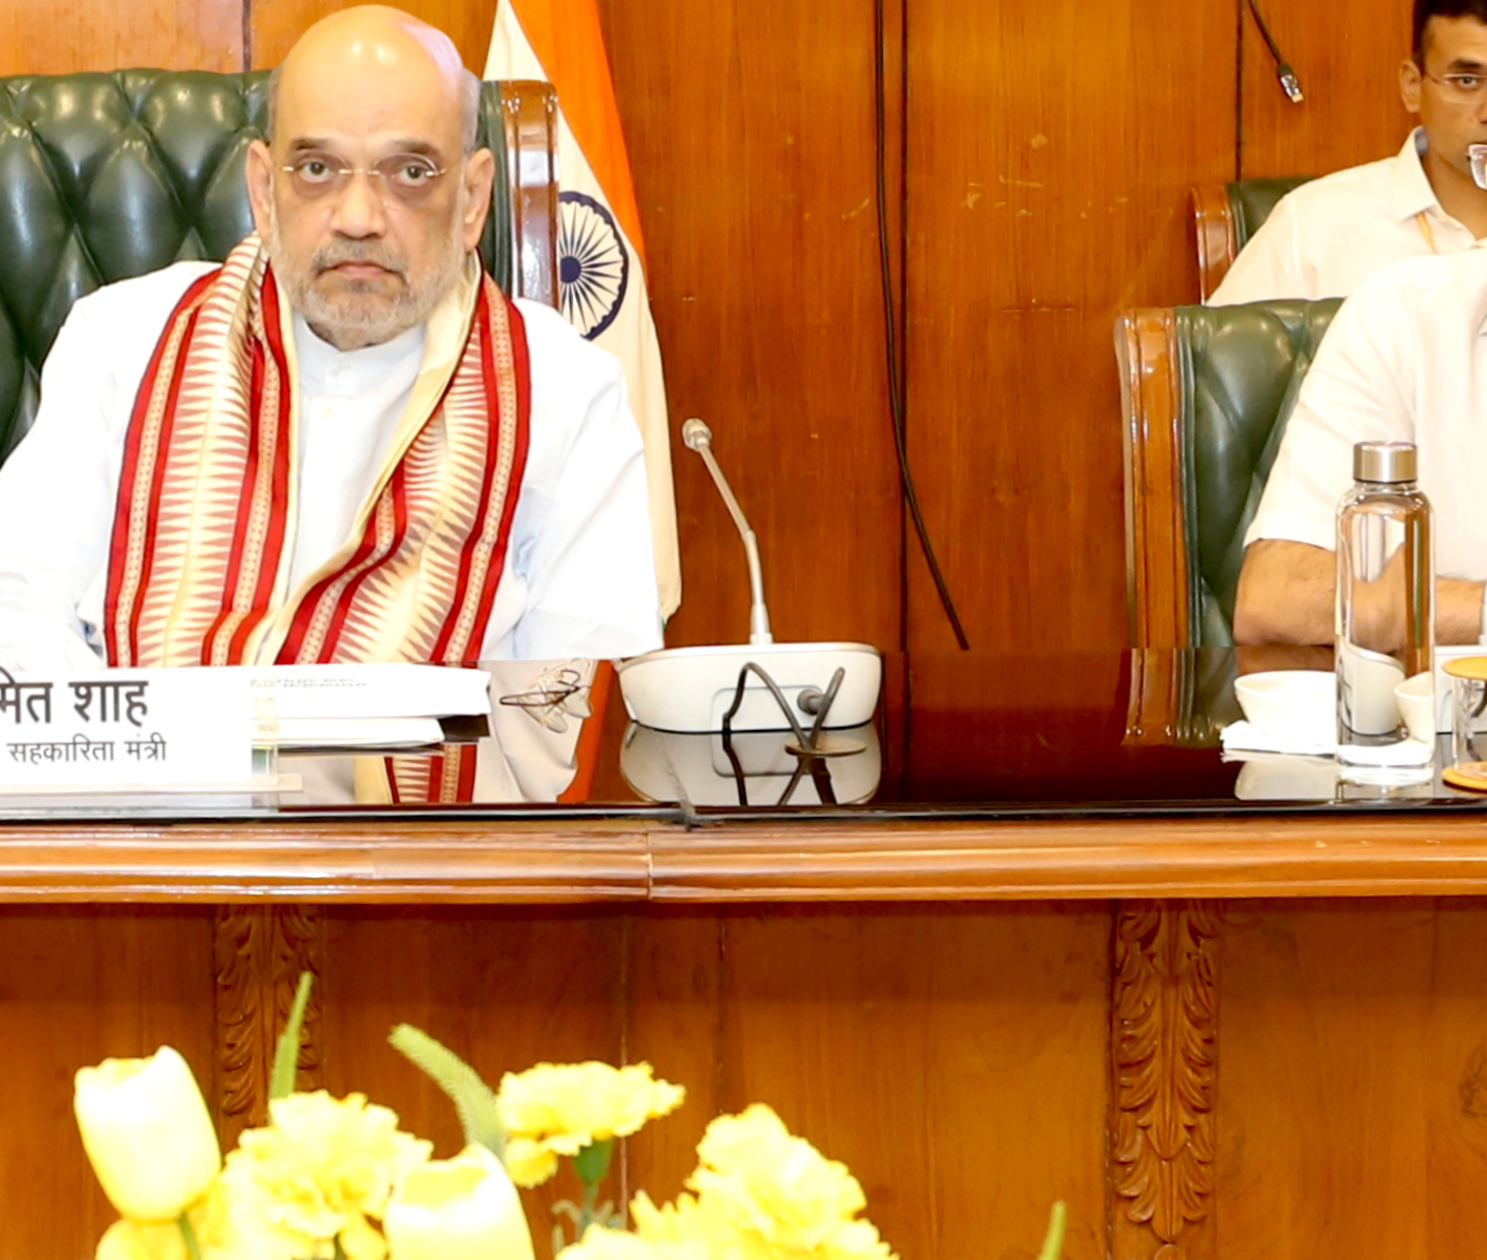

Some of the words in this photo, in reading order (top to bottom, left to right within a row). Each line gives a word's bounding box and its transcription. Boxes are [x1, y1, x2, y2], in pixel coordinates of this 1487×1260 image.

[68, 680, 150, 727] शाह
[6, 733, 115, 764] सहकारिता
[124, 732, 167, 762] मंत्री
